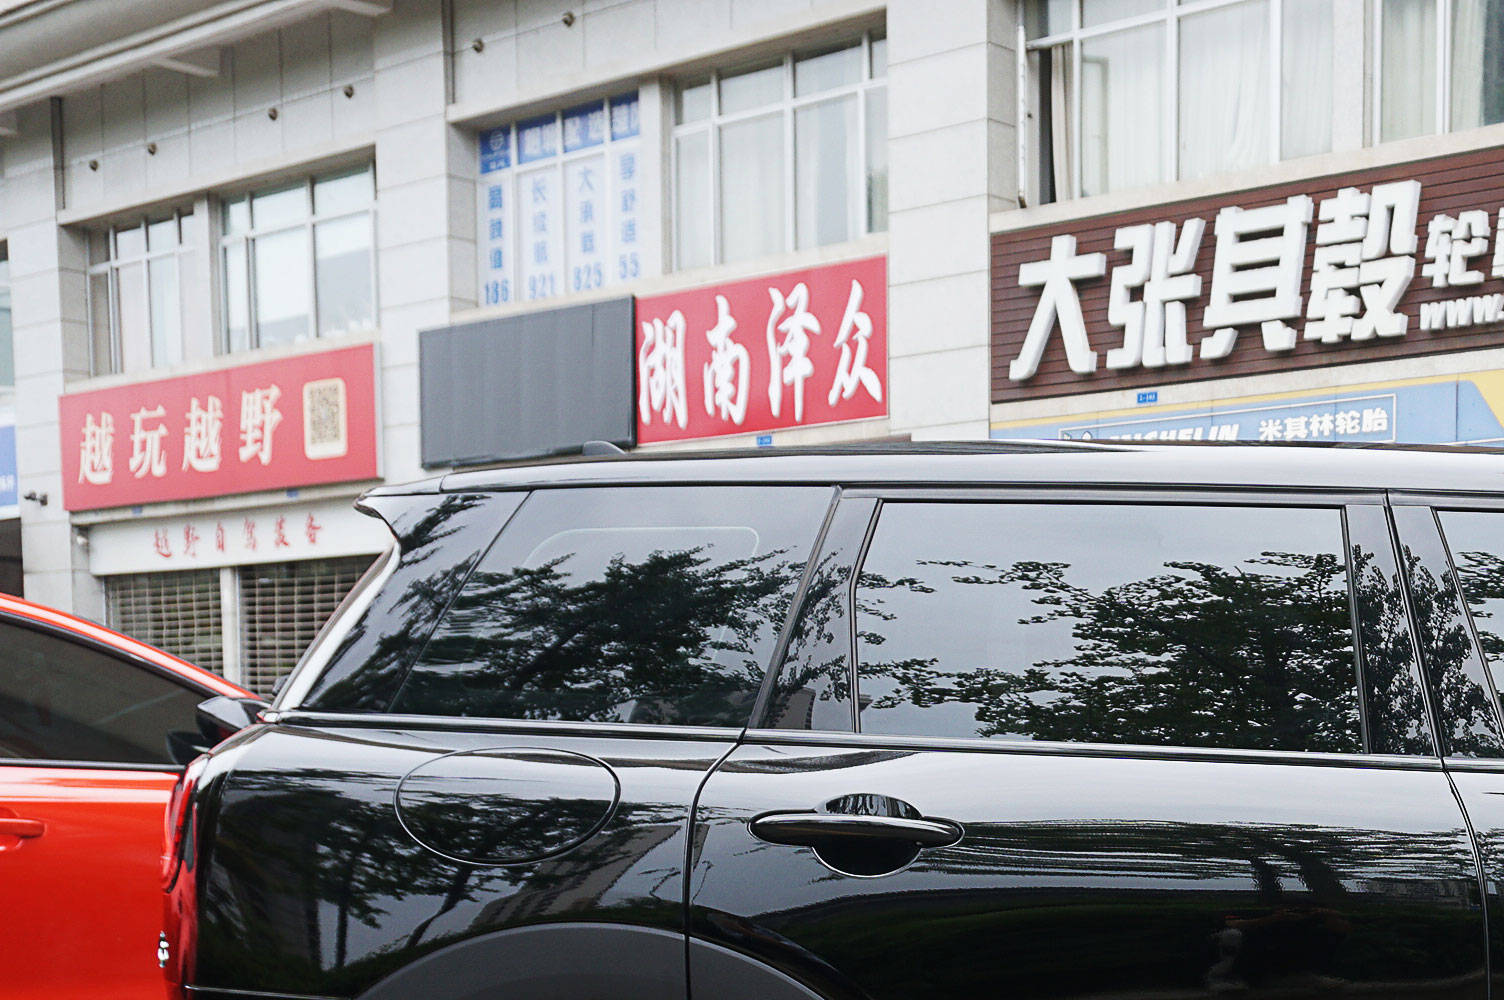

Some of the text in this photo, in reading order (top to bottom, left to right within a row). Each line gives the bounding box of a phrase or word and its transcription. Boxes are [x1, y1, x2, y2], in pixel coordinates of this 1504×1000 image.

[639, 279, 883, 430] 湖南泽众
[78, 384, 283, 485] 越玩越野
[1108, 423, 1240, 441] HELIN
[1259, 407, 1389, 441] 米其林轮胎
